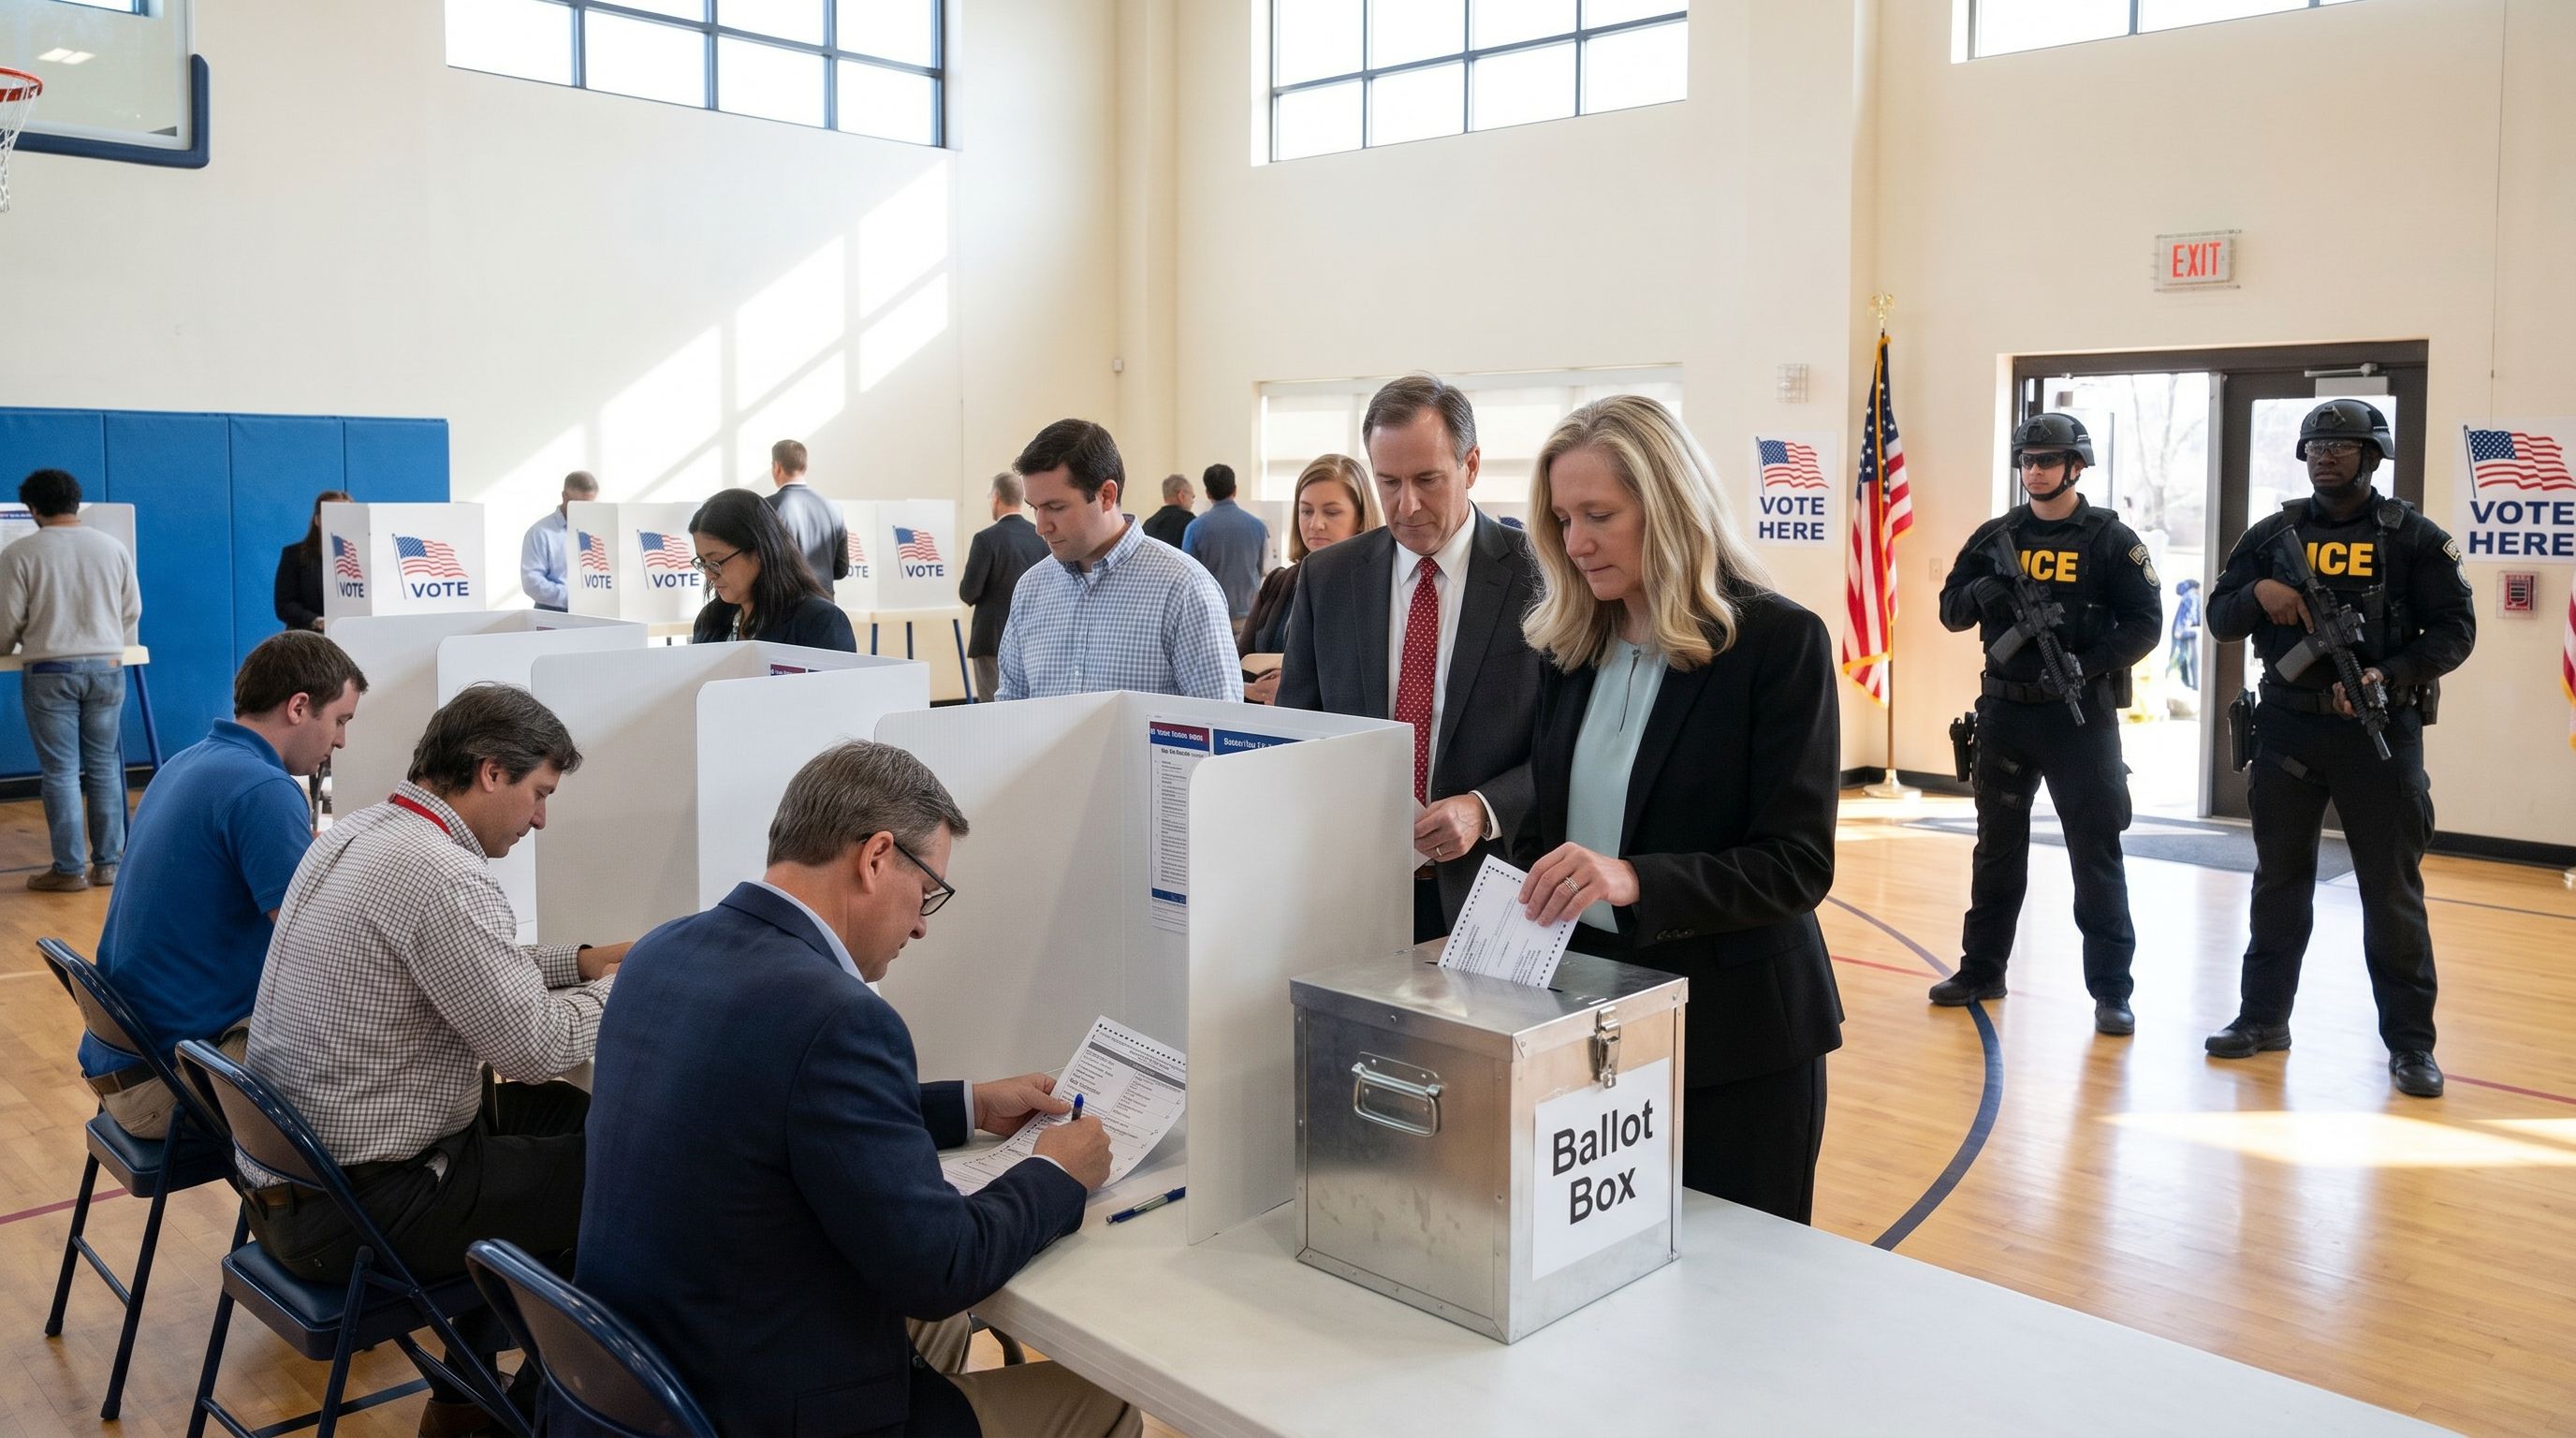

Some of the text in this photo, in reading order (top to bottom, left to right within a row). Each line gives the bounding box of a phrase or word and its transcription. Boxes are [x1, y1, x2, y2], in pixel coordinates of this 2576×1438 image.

[2173, 242, 2221, 278] EXIT
[1760, 496, 1824, 516] VOTE
[2469, 500, 2575, 525] VOTE
[1759, 521, 1824, 540] HERE
[2468, 531, 2574, 556] HERE
[651, 573, 700, 588] VOTE
[847, 565, 870, 578] OTE
[905, 565, 944, 578] VOTE
[339, 581, 365, 598] VOTE
[411, 581, 470, 597] VOTE
[584, 574, 612, 590] VOTE
[1553, 1098, 1653, 1177] Ballot
[1570, 1167, 1636, 1225] Box
